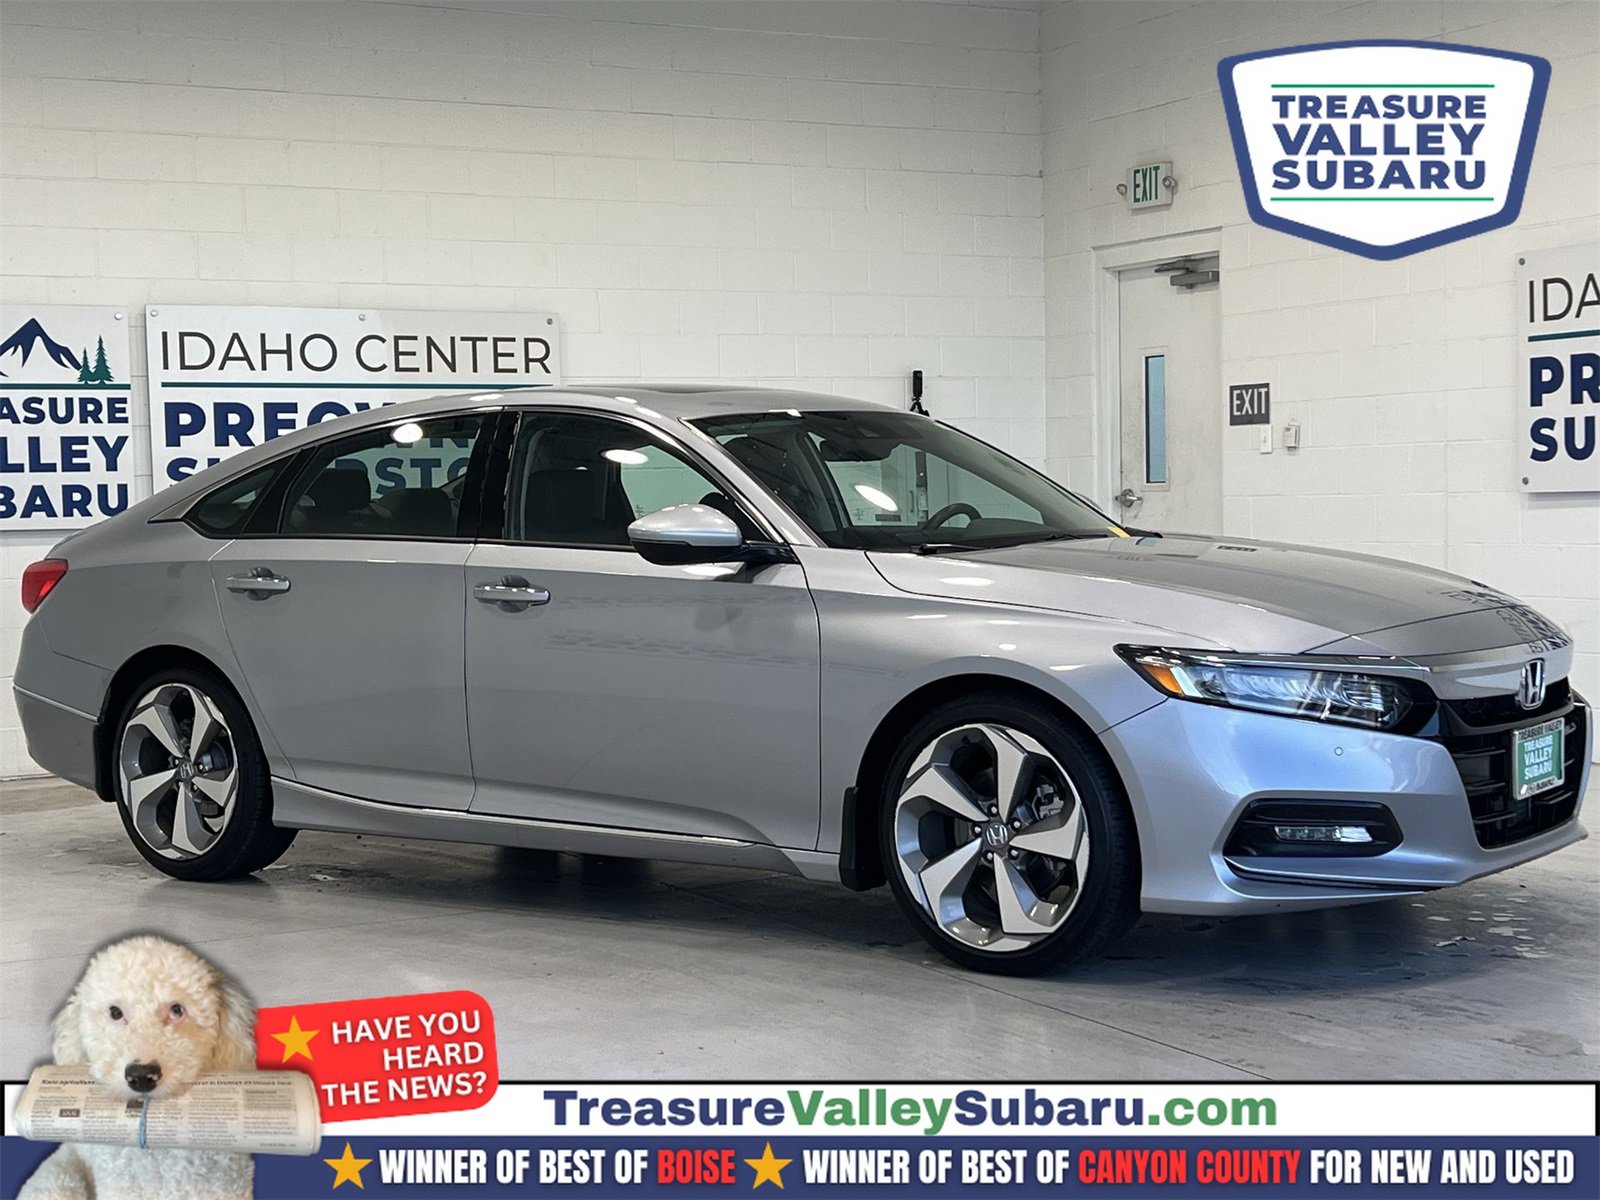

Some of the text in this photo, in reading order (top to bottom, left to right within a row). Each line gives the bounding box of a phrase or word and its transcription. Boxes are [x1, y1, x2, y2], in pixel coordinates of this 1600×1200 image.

[1133, 164, 1161, 203] EXIT
[161, 331, 551, 374] IDAHO CENTER
[1233, 387, 1268, 416] EXIT
[1523, 735, 1553, 751] TREASURE
[1523, 746, 1553, 766] VALLEY
[1523, 760, 1553, 778] SUBARU
